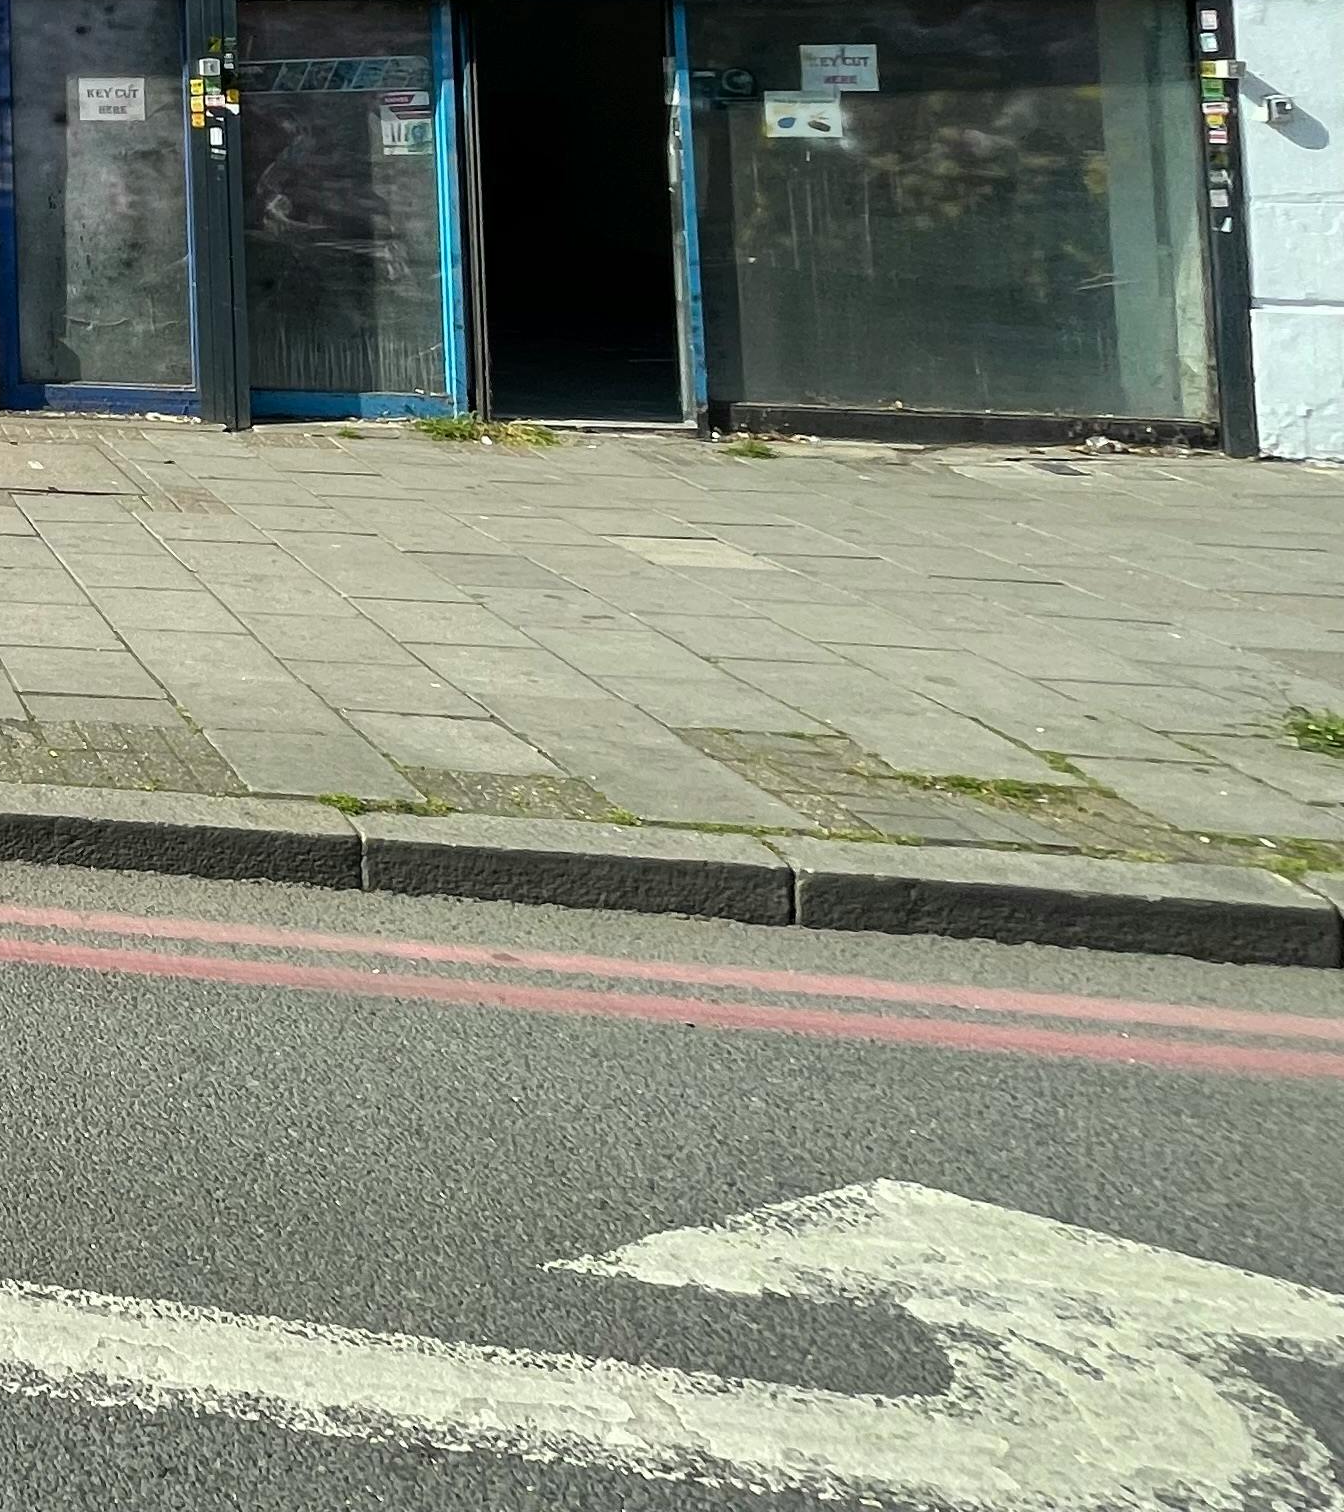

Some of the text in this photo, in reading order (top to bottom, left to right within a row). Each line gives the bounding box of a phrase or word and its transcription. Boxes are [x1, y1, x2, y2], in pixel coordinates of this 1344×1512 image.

[87, 88, 139, 98] KEY CUT
[98, 105, 128, 115] HERE
